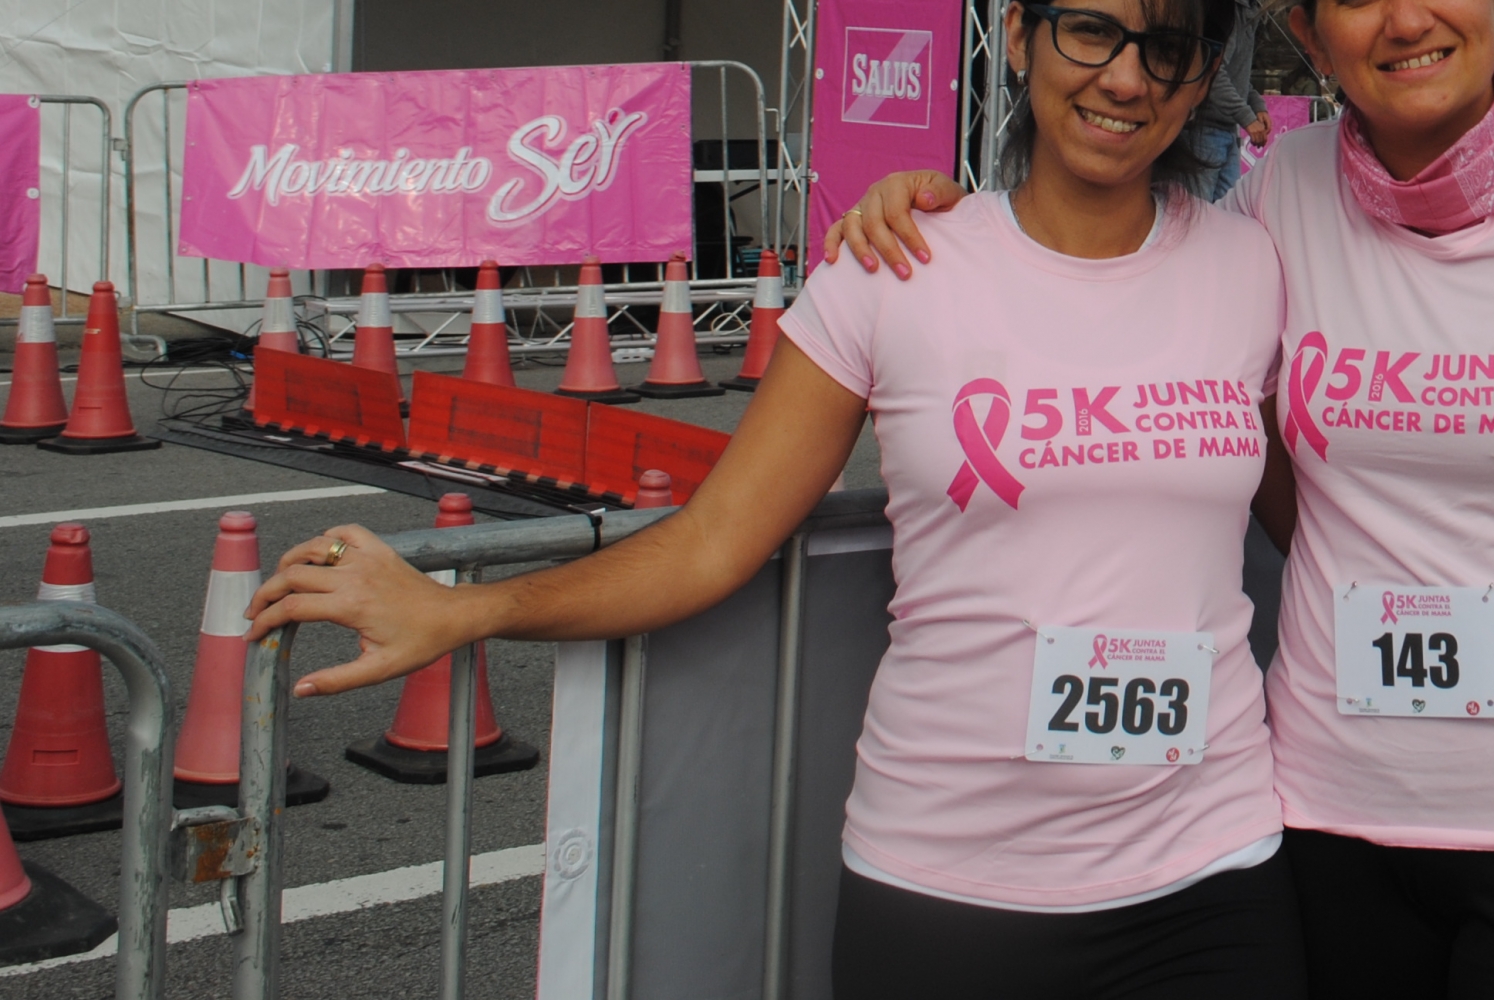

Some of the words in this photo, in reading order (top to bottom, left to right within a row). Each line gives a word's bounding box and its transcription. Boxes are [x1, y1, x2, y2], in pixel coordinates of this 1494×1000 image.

[852, 53, 922, 101] SALUS
[227, 145, 491, 206] Movimiento
[486, 108, 648, 228] Ser
[1324, 348, 1422, 404] 5K
[1371, 373, 1384, 399] 2016
[1020, 386, 1132, 441] 5K
[1133, 379, 1252, 409] JUNTAS
[1078, 408, 1089, 433] 2016
[1135, 410, 1239, 432] CONTRA
[1242, 411, 1258, 431] EL
[1321, 402, 1423, 433] CÁNCER
[1433, 413, 1466, 435] DE
[1018, 440, 1141, 469] CÁNCER
[1152, 438, 1187, 460] DE
[1198, 436, 1261, 458] MAMA
[1396, 594, 1418, 609] 5K
[1418, 595, 1451, 603] JUNTAS
[1108, 638, 1132, 653] 5K
[1132, 639, 1167, 648] JUNTAS
[1372, 632, 1460, 690] 143
[1048, 674, 1190, 736] 2563
